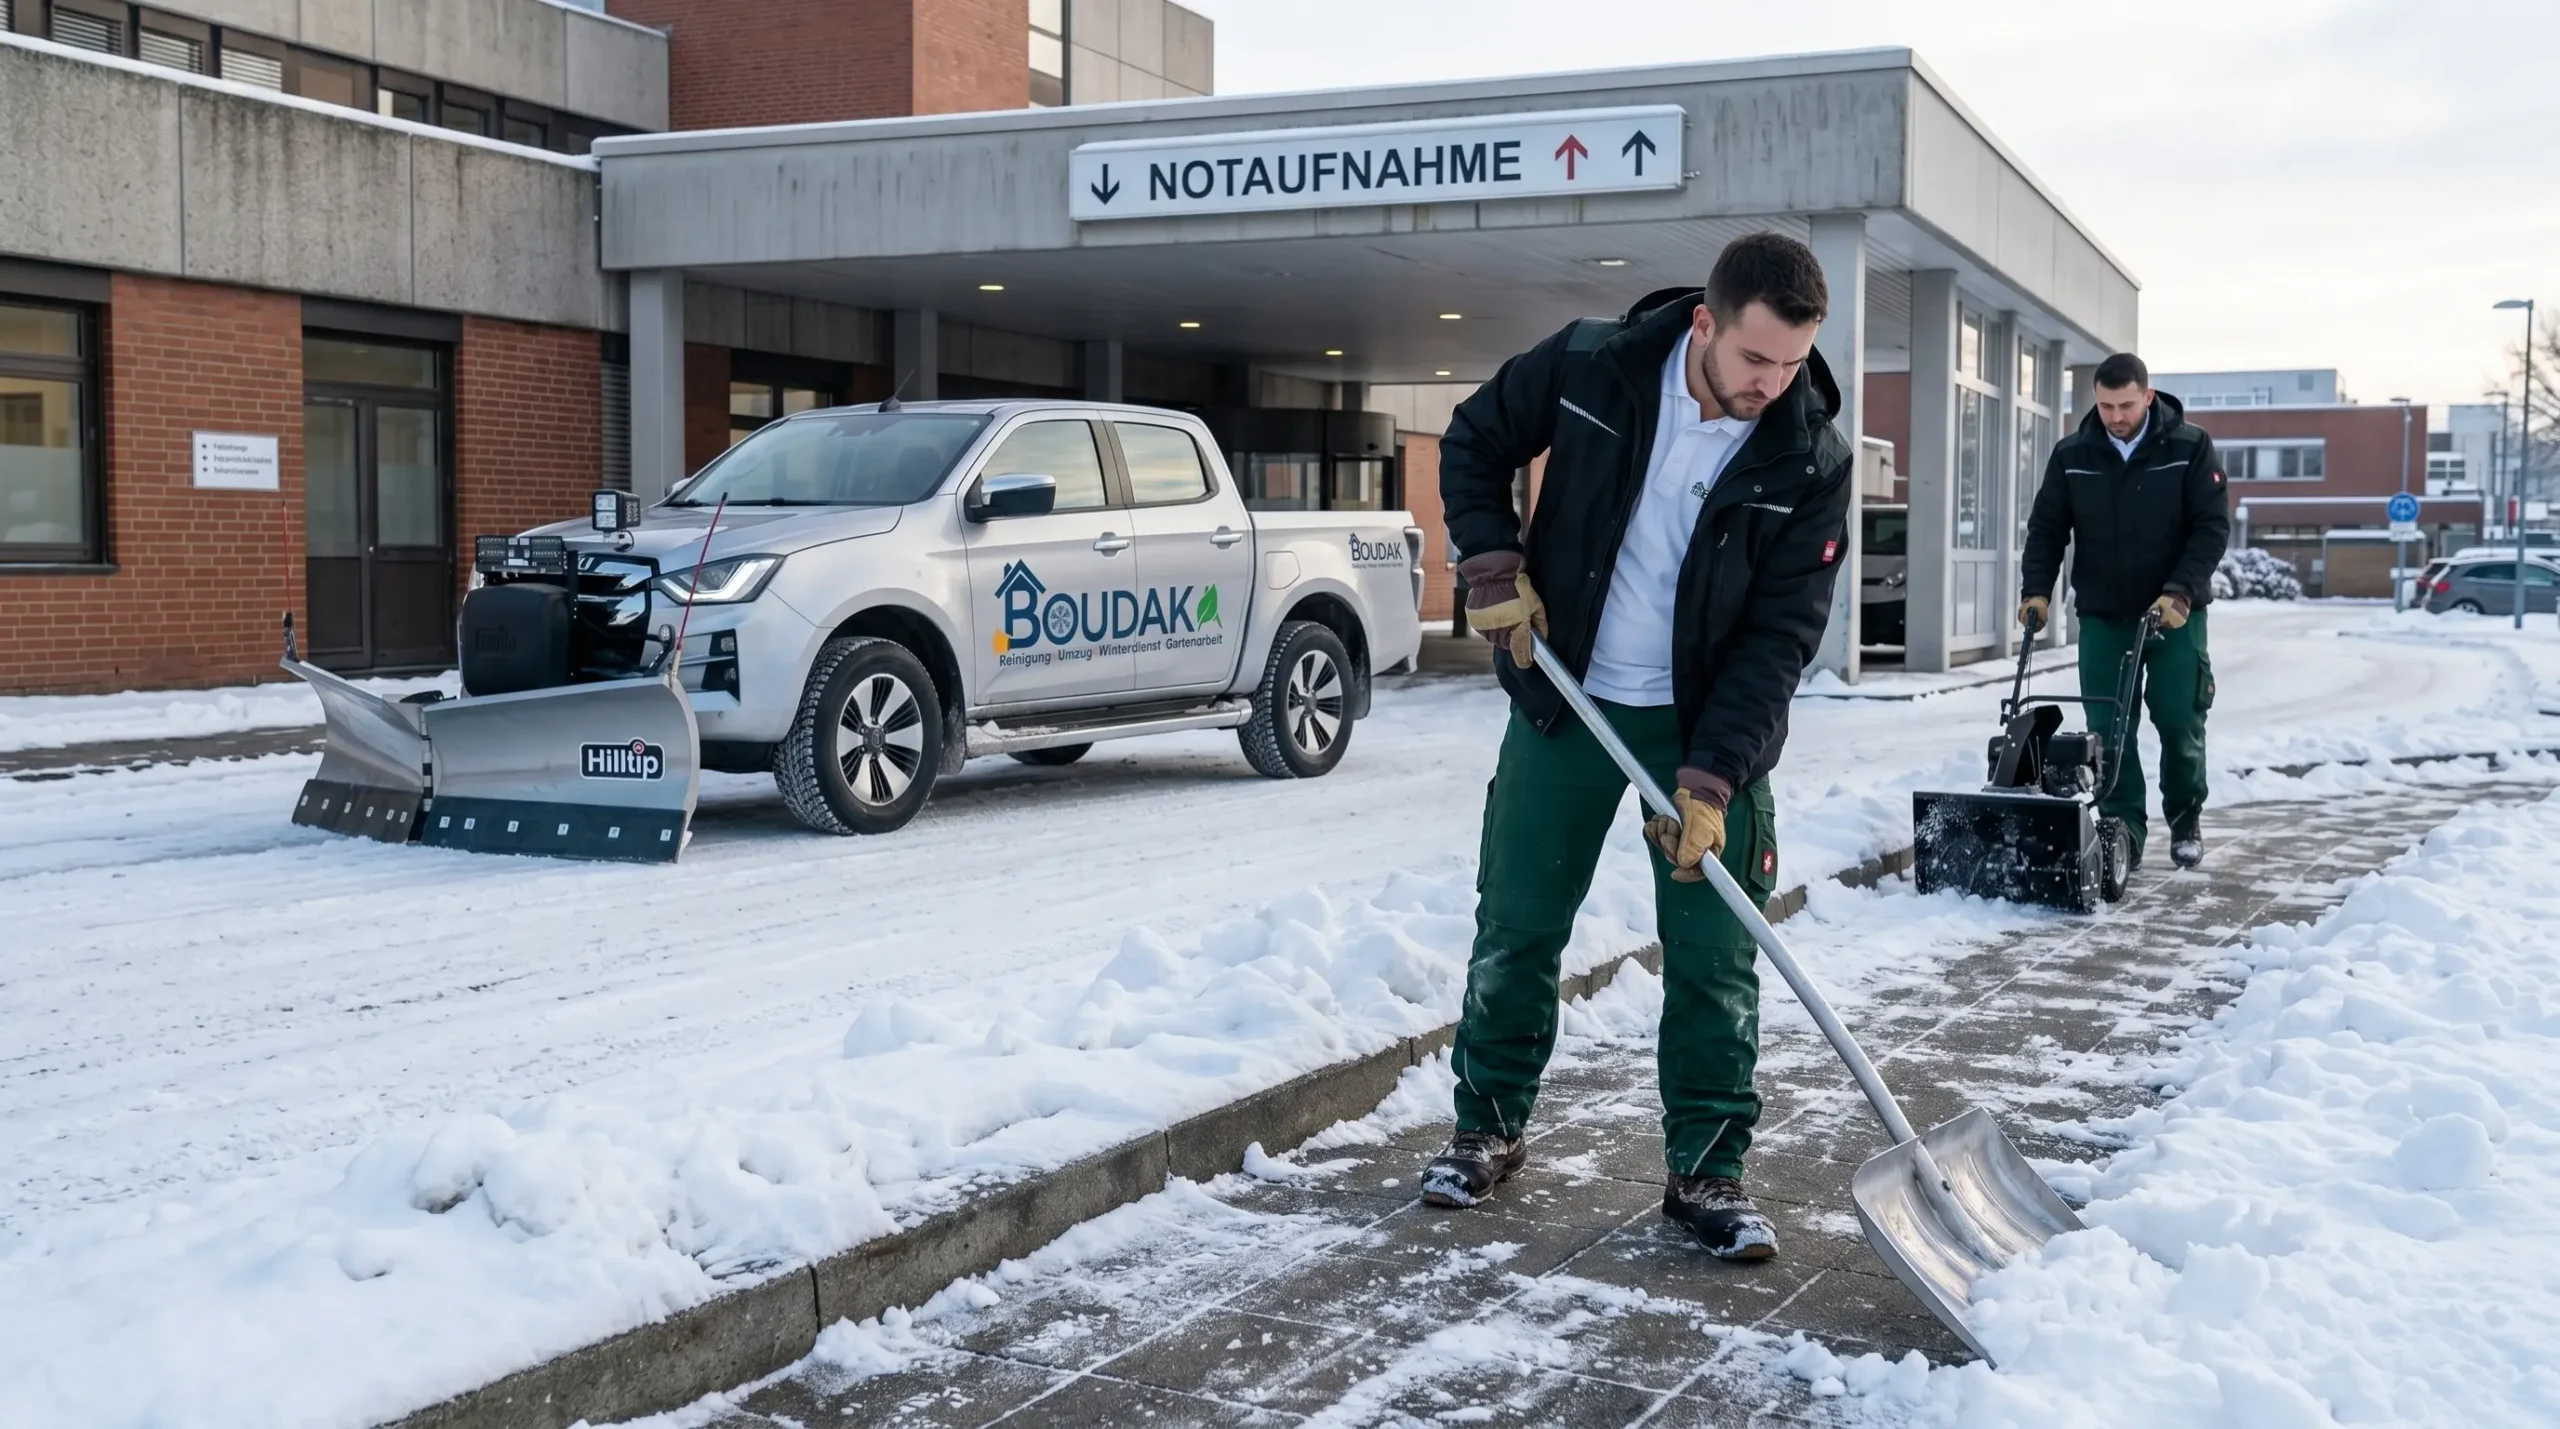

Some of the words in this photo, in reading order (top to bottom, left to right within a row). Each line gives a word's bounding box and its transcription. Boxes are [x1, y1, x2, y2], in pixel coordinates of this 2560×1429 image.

[1149, 141, 1521, 200] NOTAUFNAHME
[1351, 540, 1402, 561] BOUDAK
[1004, 583, 1195, 649] BOUDAK
[999, 653, 1051, 667] Reinigung
[1058, 648, 1092, 661] Umzug
[1166, 634, 1223, 651] Gartenarbeit
[588, 741, 659, 781] Hilltip
